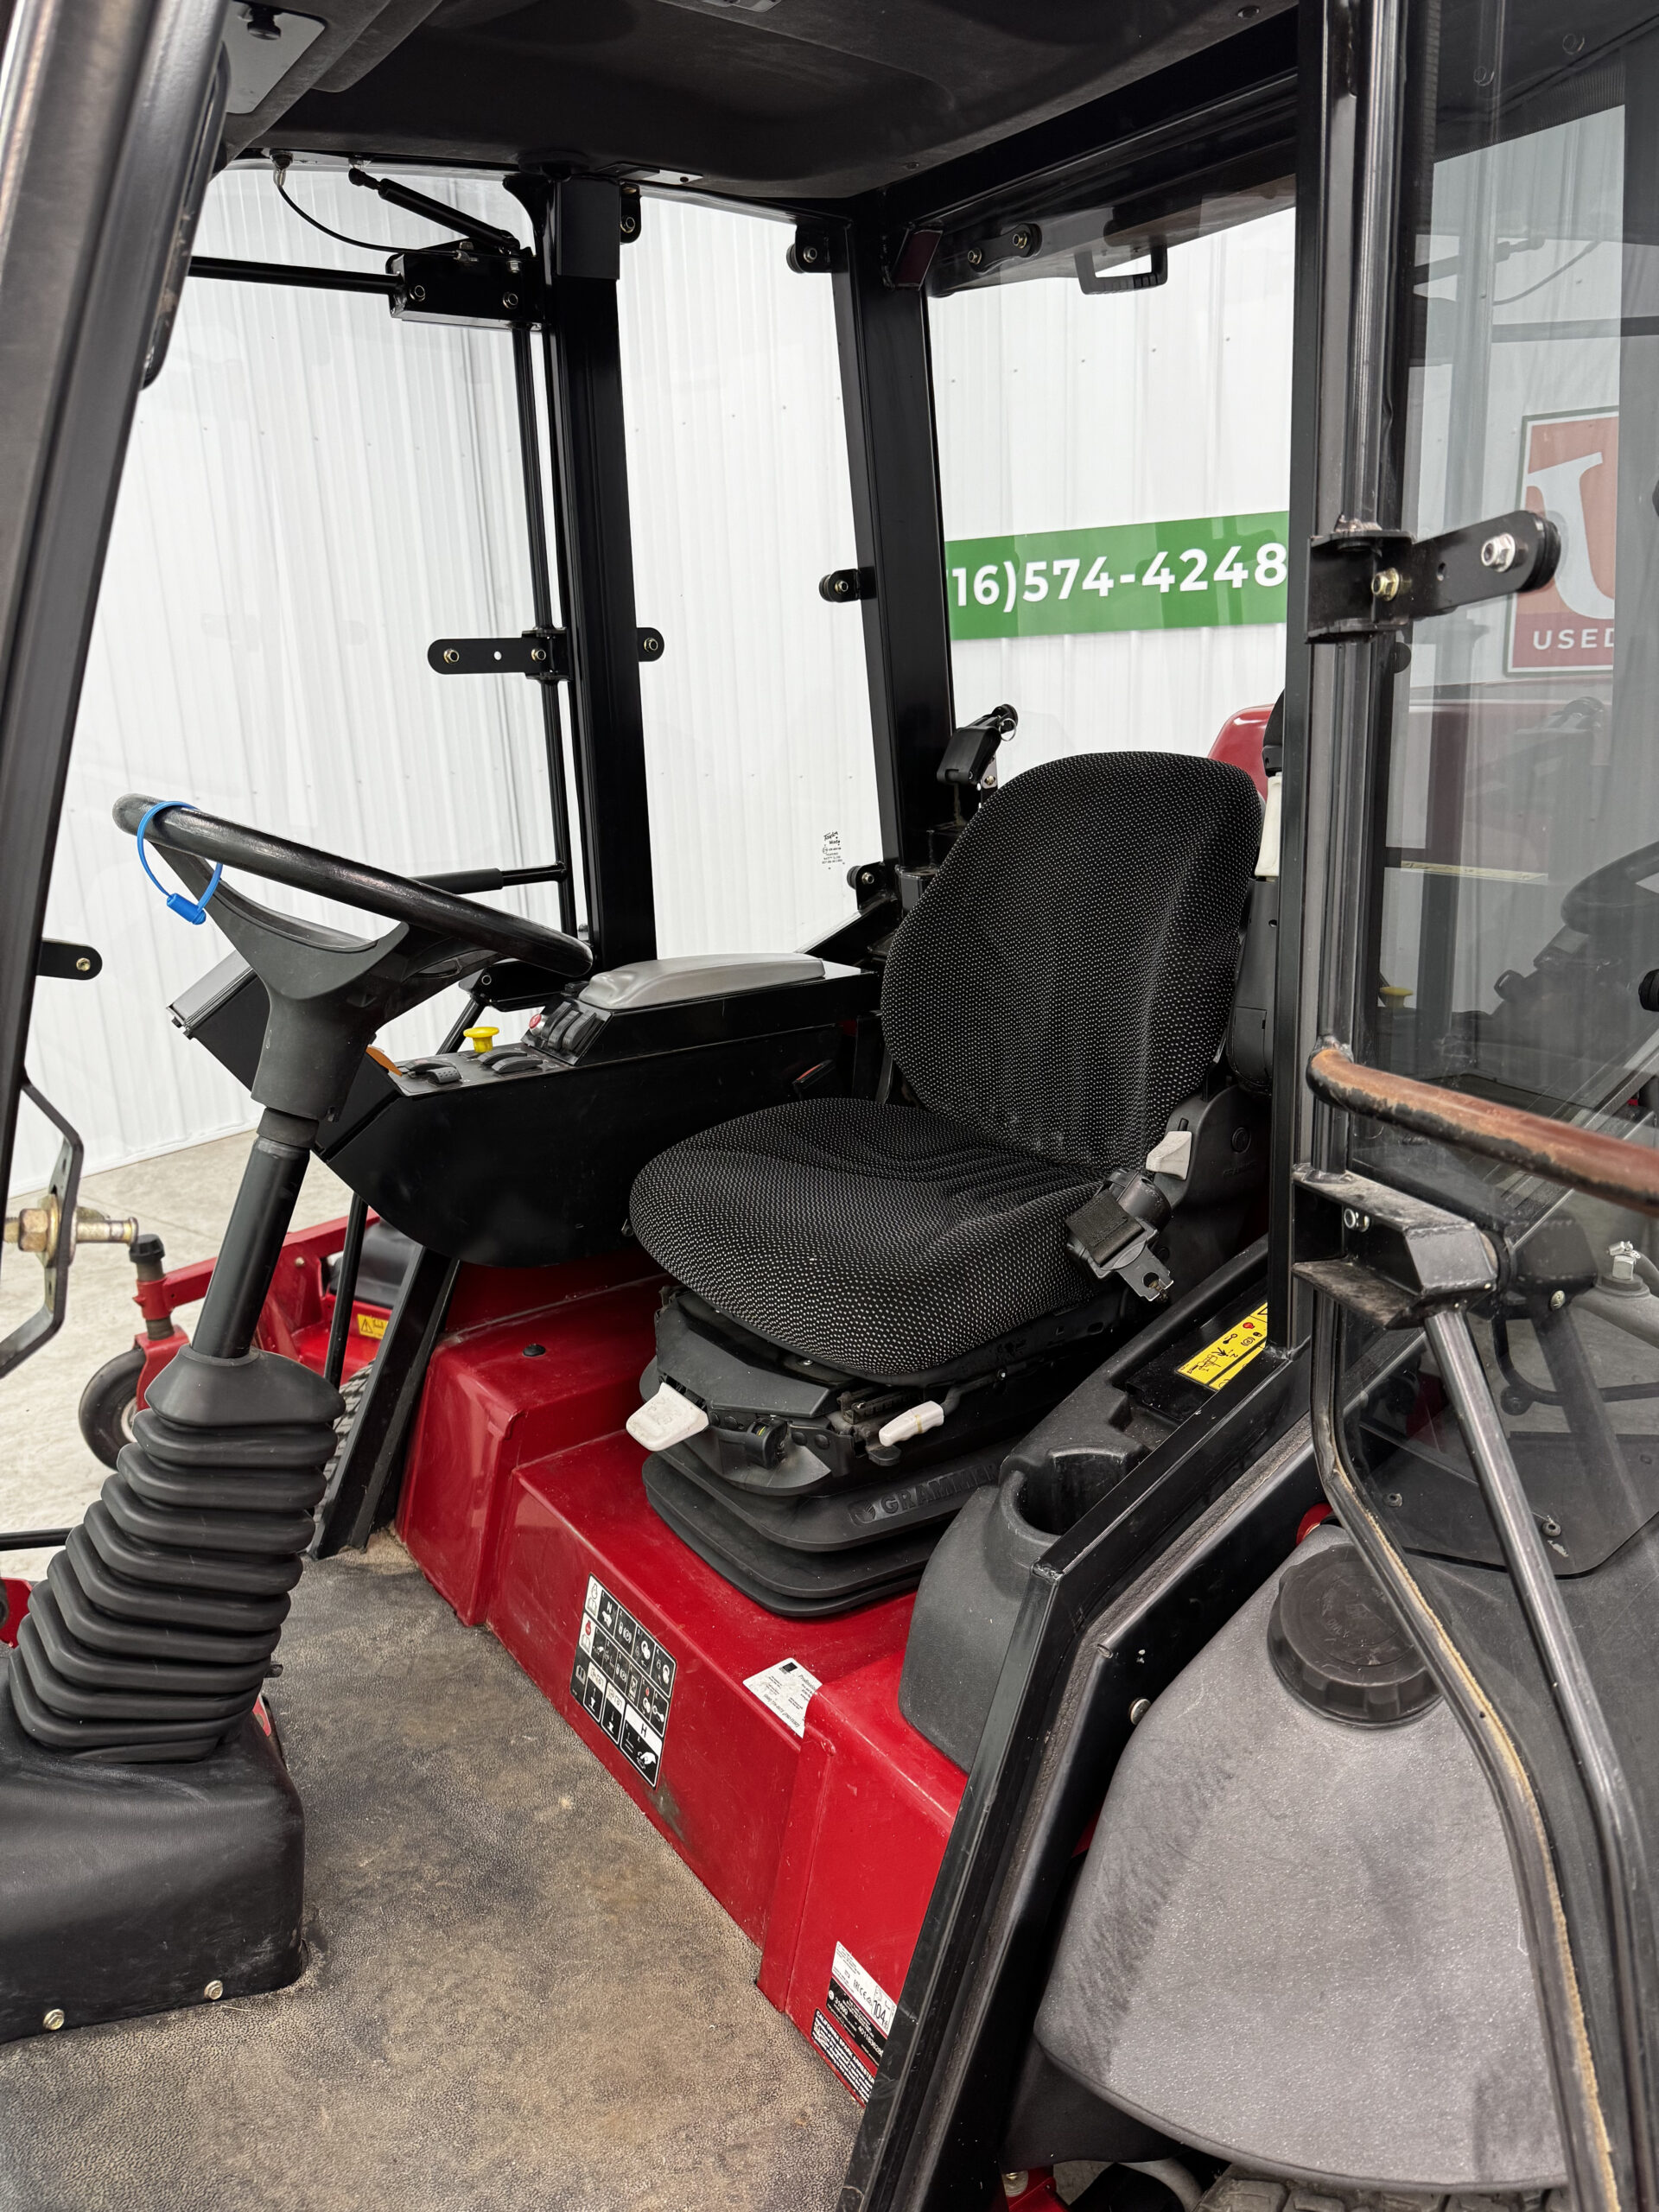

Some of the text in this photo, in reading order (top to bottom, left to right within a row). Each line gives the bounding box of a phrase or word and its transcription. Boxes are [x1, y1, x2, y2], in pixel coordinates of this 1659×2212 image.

[947, 543, 1287, 613] 16)574-4248
[607, 1601, 613, 1614] N
[640, 1723, 647, 1739] H
[816, 2010, 841, 2041] CALIFORNIA
[839, 2038, 854, 2057] SPARK
